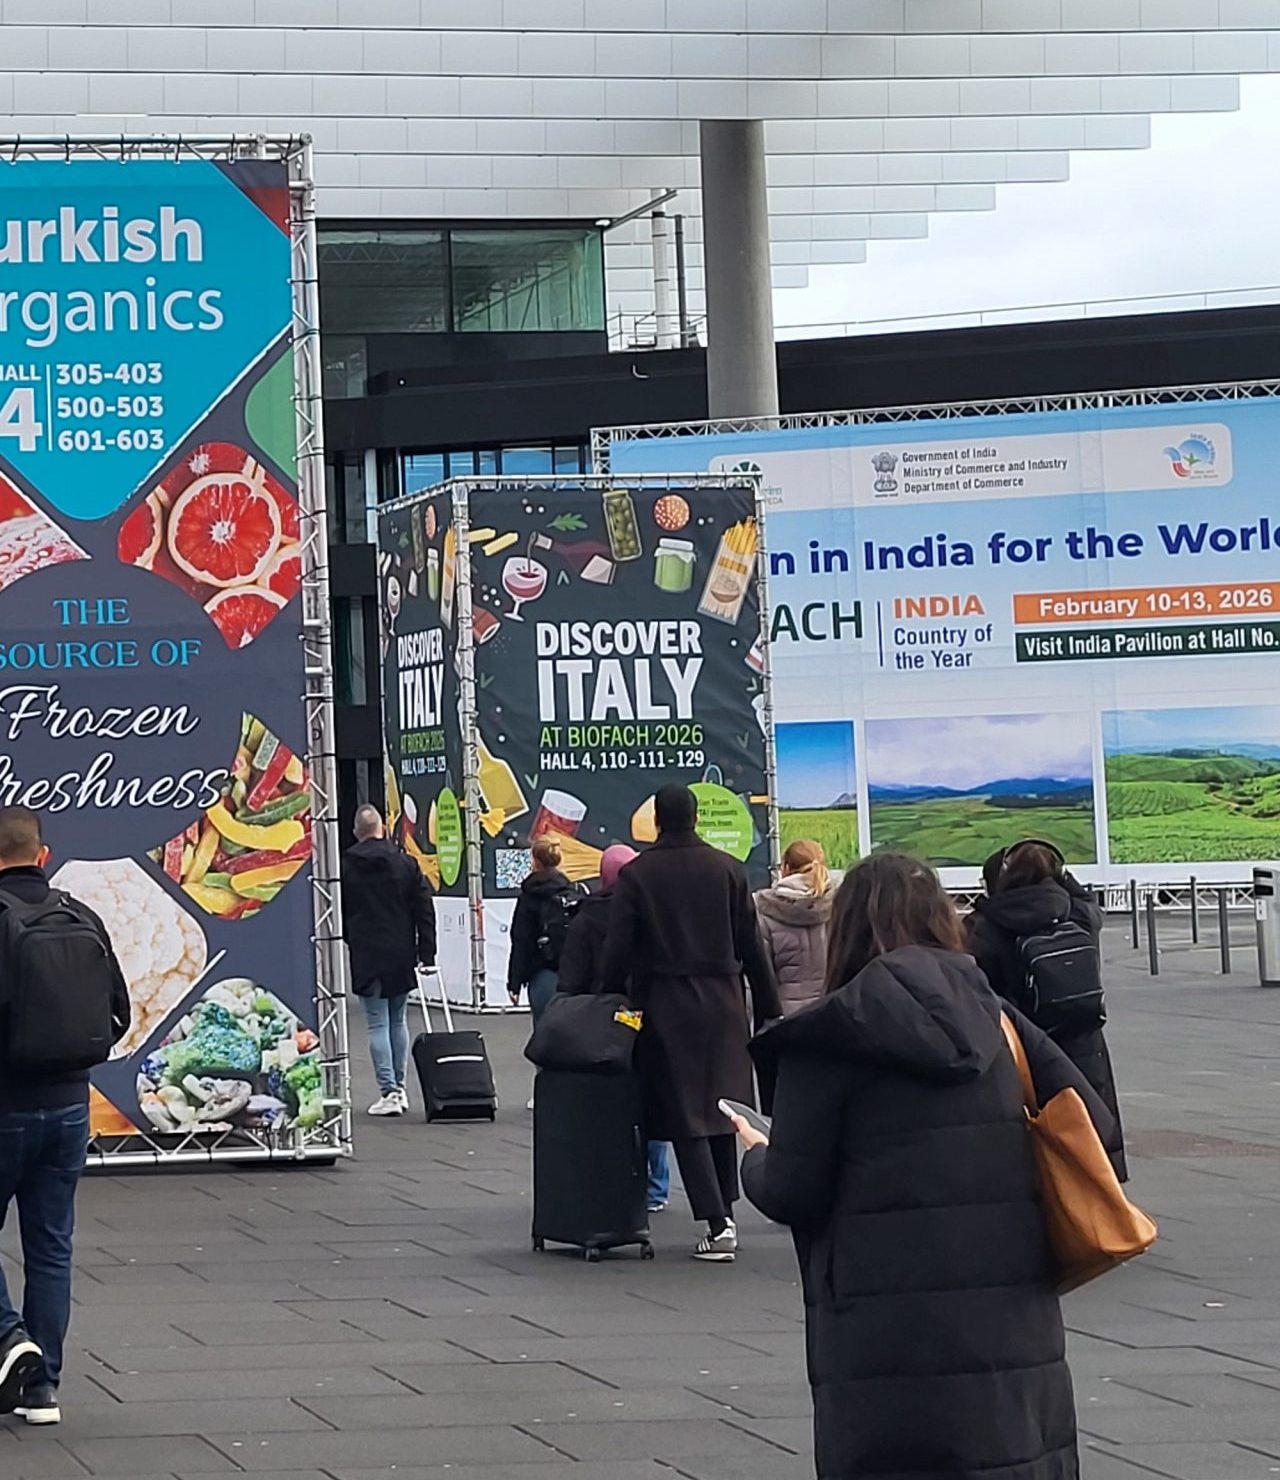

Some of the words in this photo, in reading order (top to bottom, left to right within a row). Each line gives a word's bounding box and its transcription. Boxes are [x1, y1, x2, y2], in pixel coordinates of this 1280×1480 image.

[55, 362, 163, 385] 305-403
[56, 396, 164, 419] 500-503
[57, 429, 165, 451] 601-603
[902, 450, 958, 464] Government
[961, 449, 970, 459] of
[973, 447, 997, 459] India
[903, 465, 941, 478] Ministry
[944, 464, 953, 474] of
[955, 462, 1006, 475] Commerce
[1008, 460, 1026, 472] and
[1028, 458, 1068, 472] Industry
[904, 479, 960, 494] Department
[963, 478, 972, 489] of
[974, 477, 1024, 490] Commerce
[808, 540, 850, 574] in
[864, 533, 975, 571] India
[988, 532, 1053, 565] for
[1065, 527, 1144, 560] the
[53, 598, 130, 626] THE
[894, 594, 985, 620] INDIA
[1039, 596, 1139, 618] February
[1146, 591, 1213, 613] 10-13,
[1219, 588, 1273, 609] 2026
[397, 628, 444, 668] DISCOVER
[536, 621, 703, 657] DISCOVER
[894, 625, 968, 648] Country
[974, 623, 993, 642] of
[1024, 635, 1064, 656] Visit
[1069, 633, 1111, 655] India
[1115, 632, 1183, 652] Pavilion
[1188, 631, 1206, 649] at
[1212, 628, 1246, 649] Hall
[1251, 627, 1280, 648] No.
[151, 639, 203, 667] OF
[895, 651, 925, 670] the
[931, 649, 973, 669] Year
[399, 663, 444, 730] ITALY
[538, 657, 704, 722] ITALY
[540, 726, 563, 748] AT
[568, 725, 649, 748] BIOFACH
[654, 723, 704, 747] 2026
[540, 752, 580, 770] HALL
[581, 751, 597, 772] 4,
